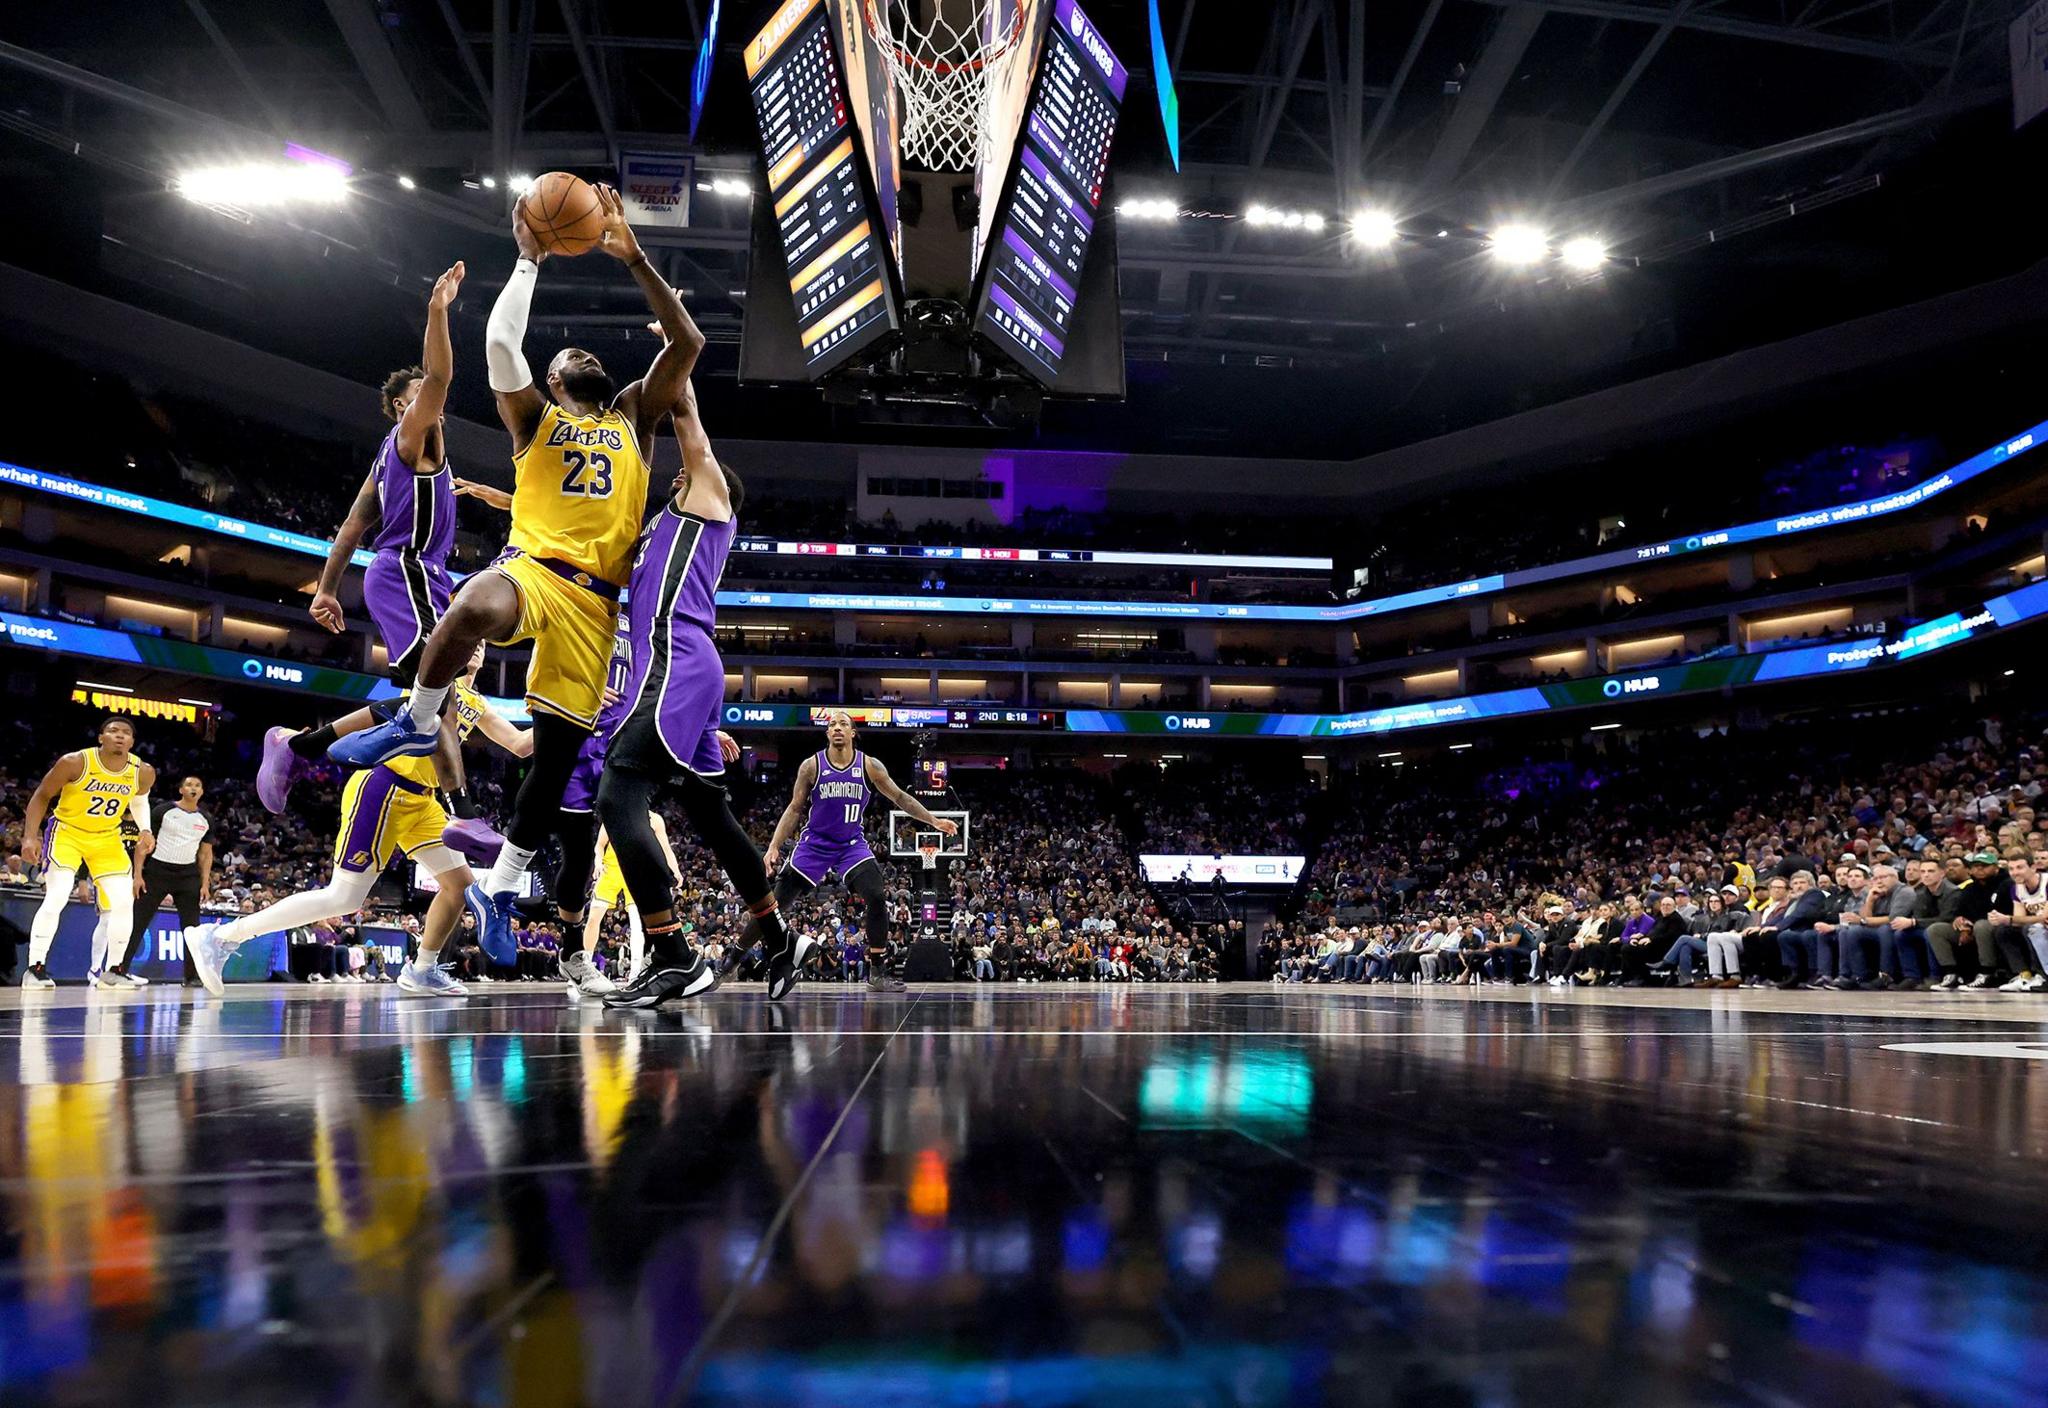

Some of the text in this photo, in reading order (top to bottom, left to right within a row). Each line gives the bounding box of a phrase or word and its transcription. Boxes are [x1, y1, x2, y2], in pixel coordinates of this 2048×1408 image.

[1082, 26, 1114, 78] KINGS
[638, 194, 681, 206] TRAIN
[545, 420, 623, 450] LAKERS
[2007, 434, 2033, 454] HUB
[561, 449, 613, 499] 23
[0, 467, 148, 511] what matters most.
[1776, 474, 1953, 532] Protect what matters most.
[218, 519, 246, 534] HUB
[751, 543, 768, 551] BKN
[1702, 533, 1728, 546] HUB
[750, 595, 771, 604] HUB
[809, 596, 847, 607] Protect
[848, 597, 874, 607] what
[875, 598, 914, 608] matters
[10, 623, 58, 641] most.
[1827, 645, 1883, 664] Protect
[1885, 637, 1914, 655] what
[266, 664, 303, 683] HUB
[1624, 677, 1659, 693] HUB
[744, 710, 774, 721] HUB
[911, 711, 932, 720] SAC
[978, 711, 999, 721] 2ND
[1182, 717, 1211, 729] HUB
[1330, 718, 1368, 731] Protect
[83, 778, 132, 795] LAKERS
[932, 771, 942, 788] 5
[819, 781, 863, 800] SACRAMENTO
[87, 796, 120, 817] 28
[844, 803, 861, 824] 10
